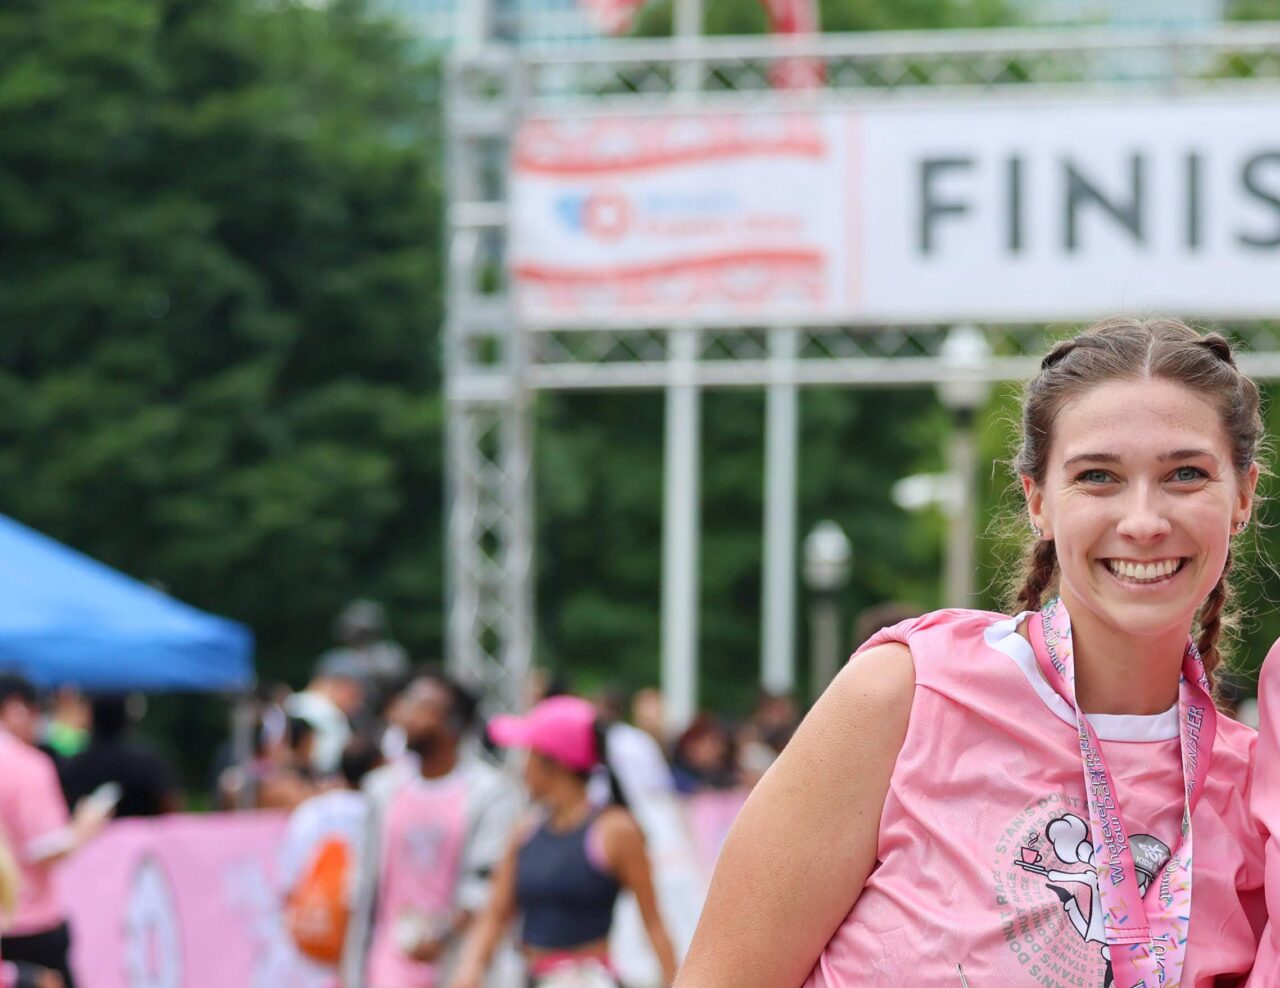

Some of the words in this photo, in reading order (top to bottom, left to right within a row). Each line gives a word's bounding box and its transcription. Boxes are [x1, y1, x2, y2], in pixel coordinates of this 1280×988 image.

[1092, 749, 1116, 809] Donuts
[1098, 798, 1125, 887] Whatever
[1112, 816, 1128, 854] Your
[1136, 855, 1154, 870] KIDS
[1041, 953, 1085, 987] STAN'S
